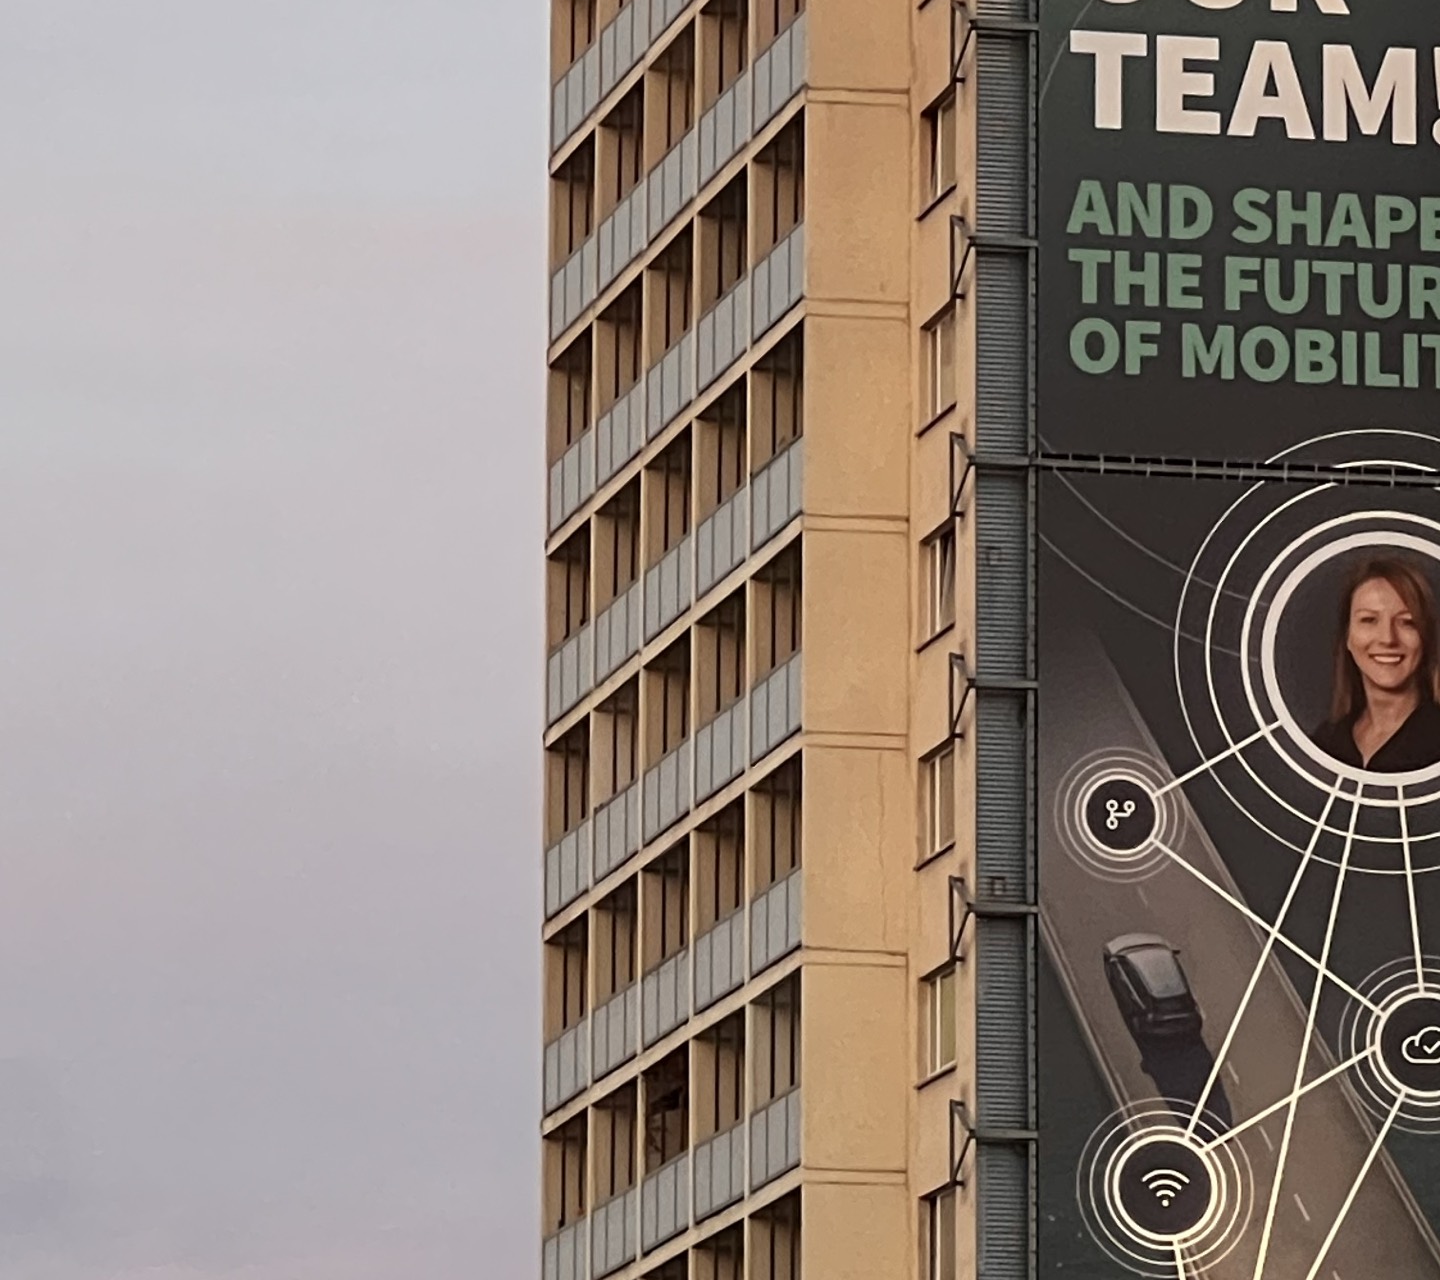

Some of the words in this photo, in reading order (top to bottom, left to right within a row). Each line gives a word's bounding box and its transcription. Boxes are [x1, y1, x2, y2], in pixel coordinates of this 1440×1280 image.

[1066, 179, 1213, 240] AND
[1068, 248, 1204, 309] THE
[1069, 317, 1161, 375] OF
